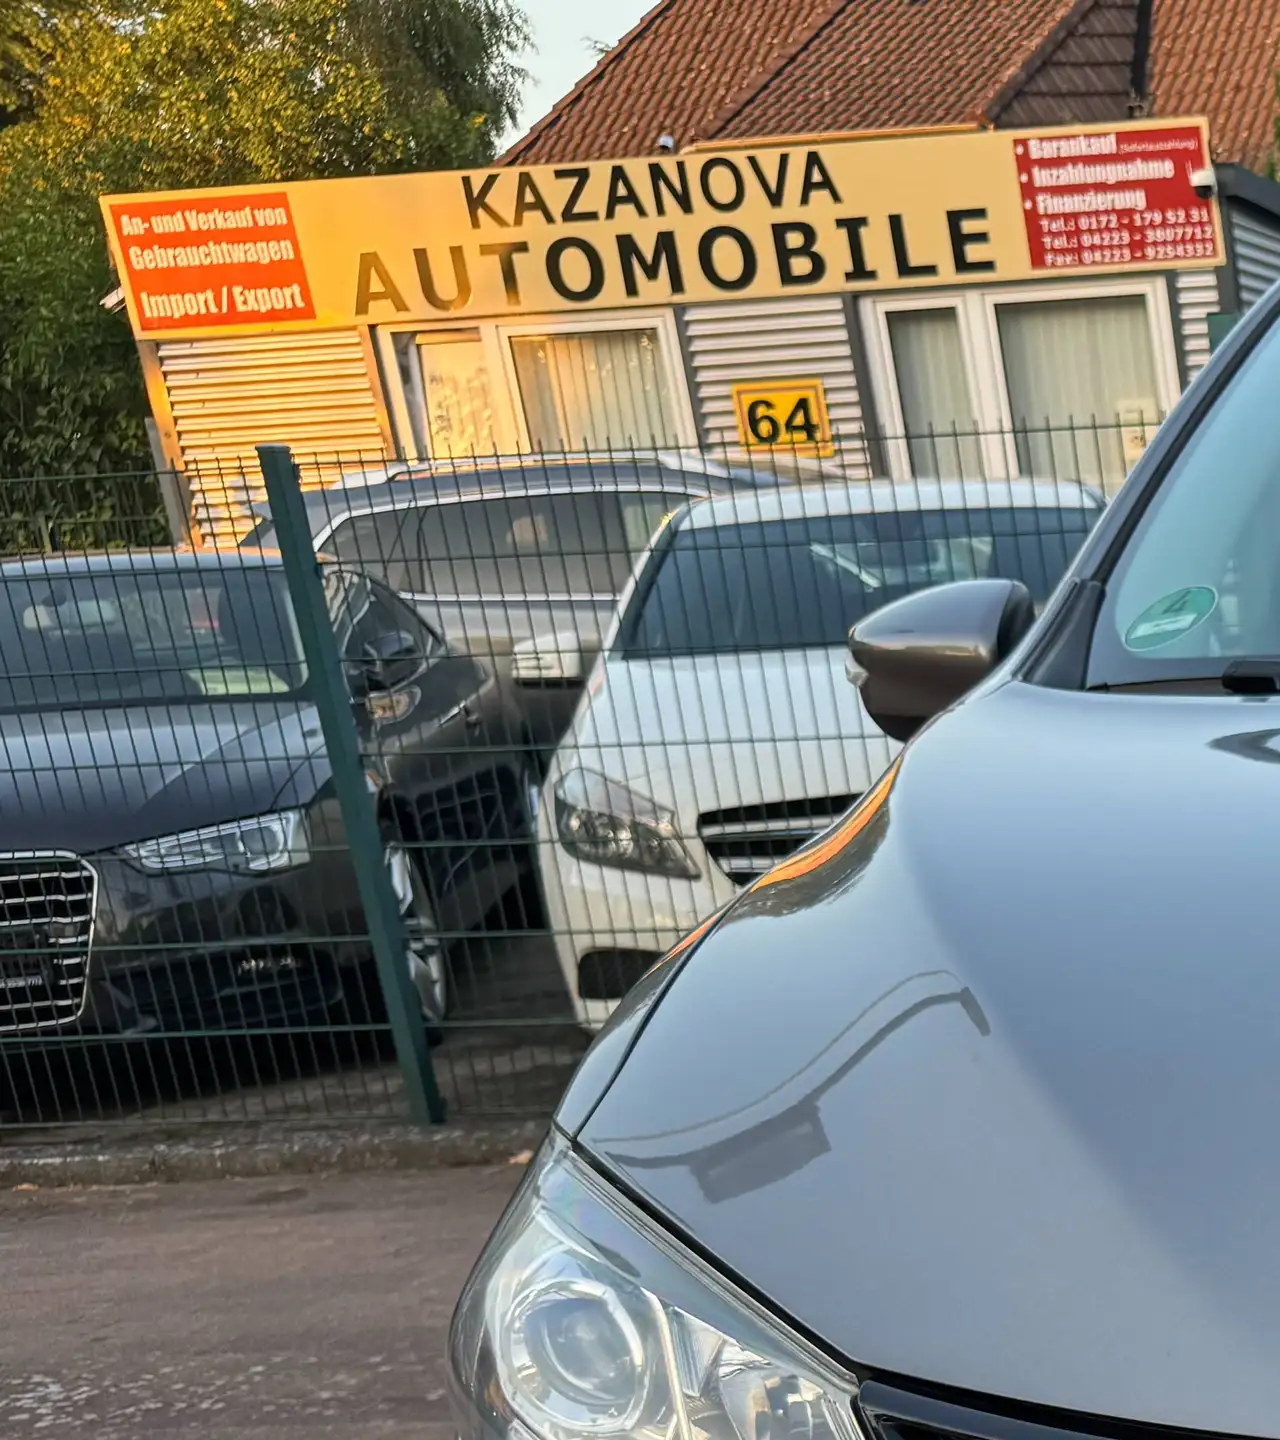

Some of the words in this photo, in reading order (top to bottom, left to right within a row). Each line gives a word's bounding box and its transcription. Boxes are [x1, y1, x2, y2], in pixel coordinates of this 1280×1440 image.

[1031, 158, 1175, 187] Inzahlungnahme
[461, 151, 843, 230] KAZANOVA
[1035, 188, 1147, 215] Finanzierung
[120, 214, 150, 236] An-
[151, 211, 186, 234] und
[184, 206, 254, 232] Verkauf
[253, 207, 288, 227] von
[1077, 212, 1119, 231] 0172
[1131, 209, 1163, 227] 179
[1188, 205, 1209, 222] 31
[1080, 228, 1130, 247] 04223
[1143, 224, 1213, 243] 3807712
[128, 239, 295, 271] Gebrauchtwagen
[354, 206, 997, 317] AUTOMOBILE
[1080, 246, 1131, 265] 04223
[140, 286, 219, 319] Import
[221, 285, 229, 314] /
[231, 283, 305, 313] Export
[748, 397, 819, 444] 64
